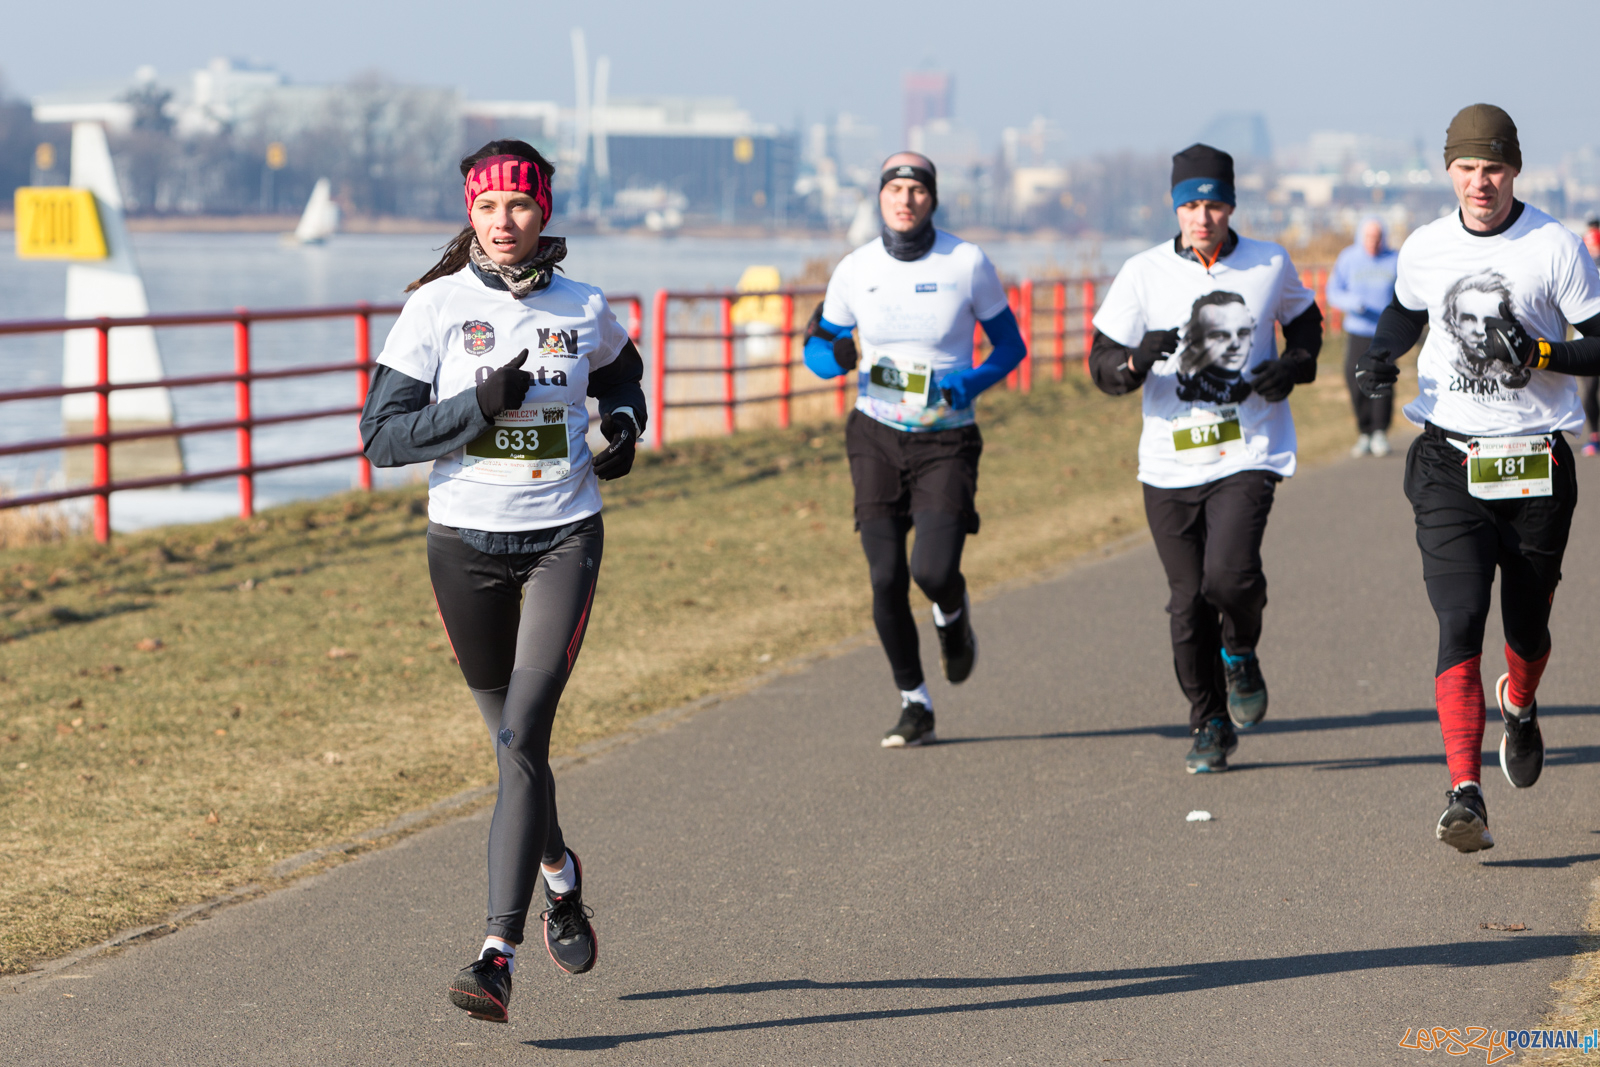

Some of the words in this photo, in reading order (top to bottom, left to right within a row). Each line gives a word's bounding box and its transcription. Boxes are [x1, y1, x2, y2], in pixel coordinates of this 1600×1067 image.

[495, 429, 540, 451] 633
[1190, 424, 1220, 444] 871
[1494, 456, 1525, 476] 181
